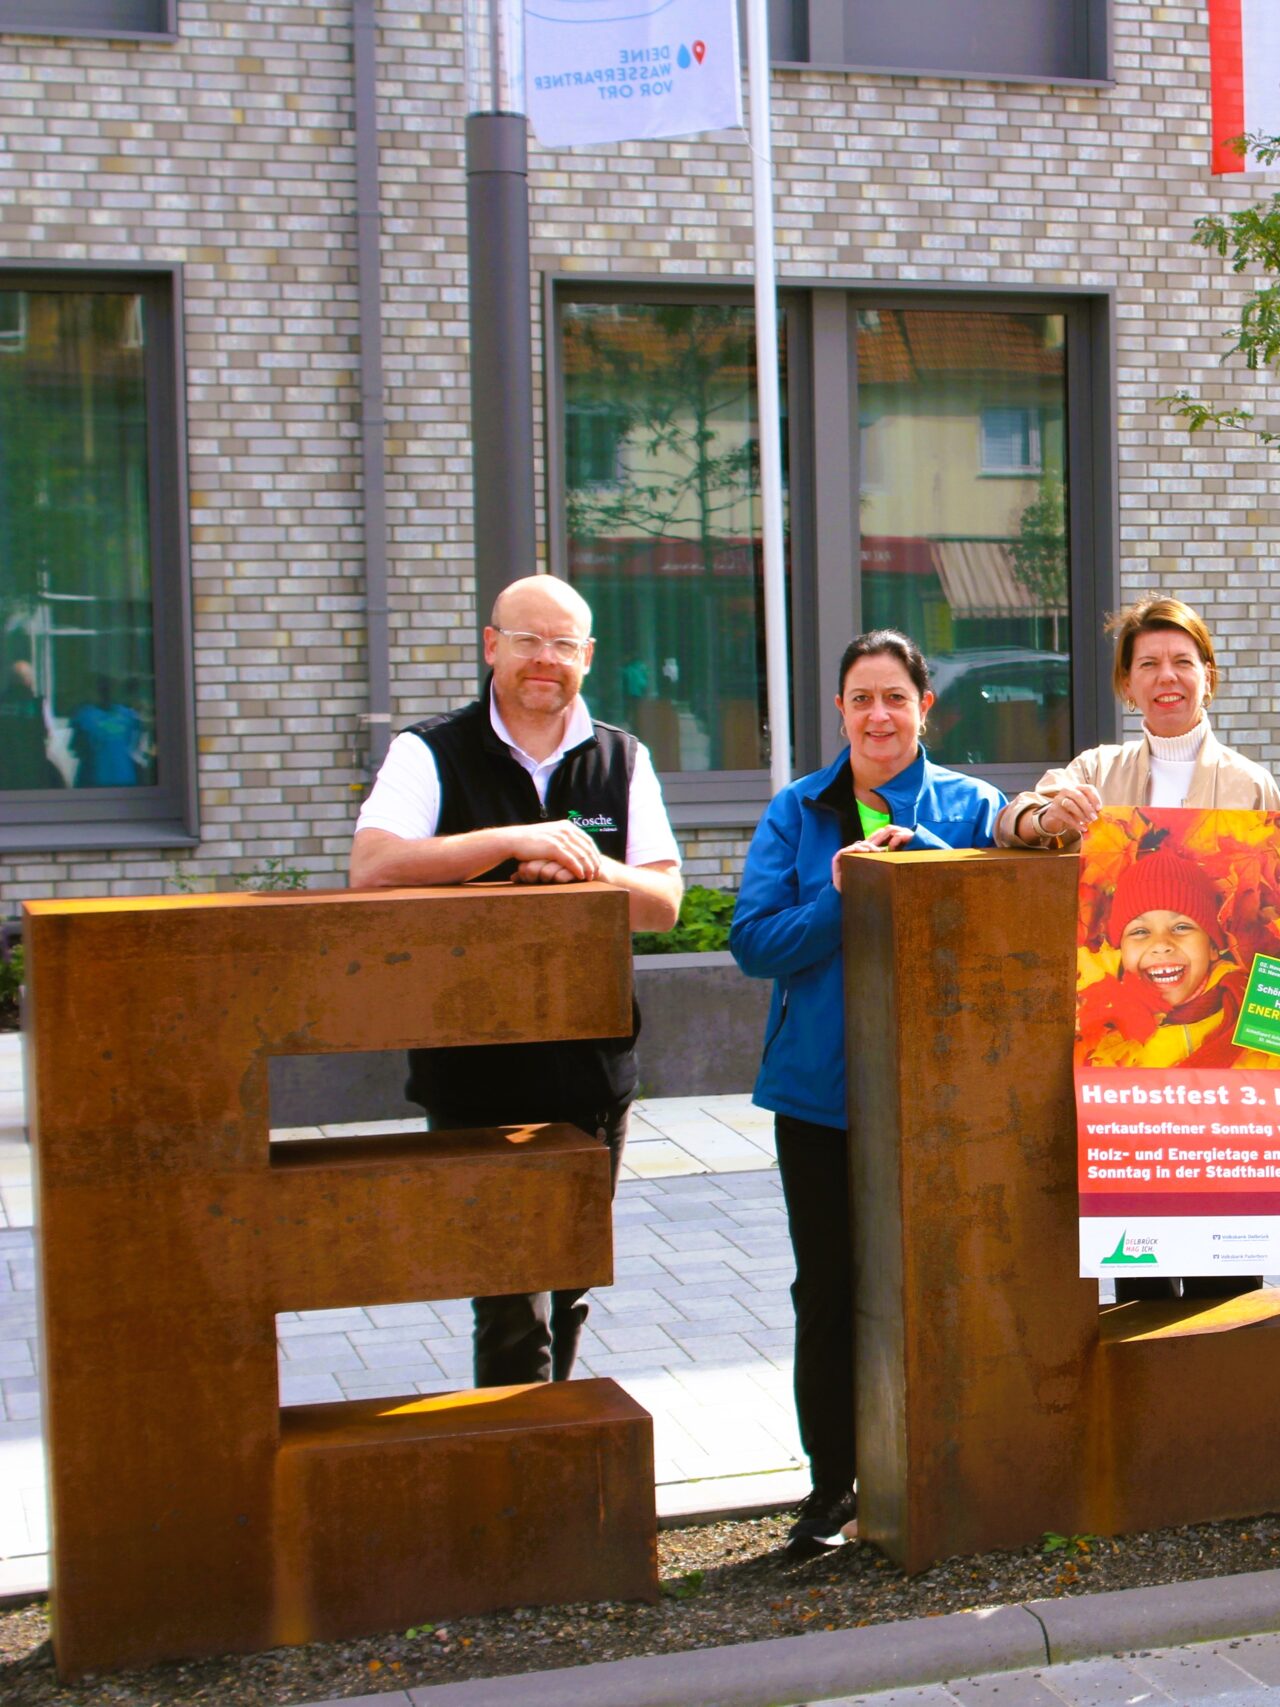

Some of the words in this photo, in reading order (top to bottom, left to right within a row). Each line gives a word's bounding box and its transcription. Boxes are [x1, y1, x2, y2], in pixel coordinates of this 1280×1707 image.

[573, 813, 612, 826] Kosche
[1082, 1084, 1229, 1105] Herbstfest
[1240, 1086, 1266, 1105] 3.
[1087, 1122, 1206, 1135] verkaufsoffener
[1210, 1123, 1273, 1137] Sonntag
[1087, 1148, 1129, 1161] Holz-
[1135, 1148, 1163, 1161] und
[1168, 1148, 1258, 1163] Energietage
[1087, 1166, 1150, 1181] Sonntag
[1156, 1166, 1170, 1178] in
[1175, 1166, 1200, 1178] der
[1126, 1237, 1159, 1245] DELBRÜCK
